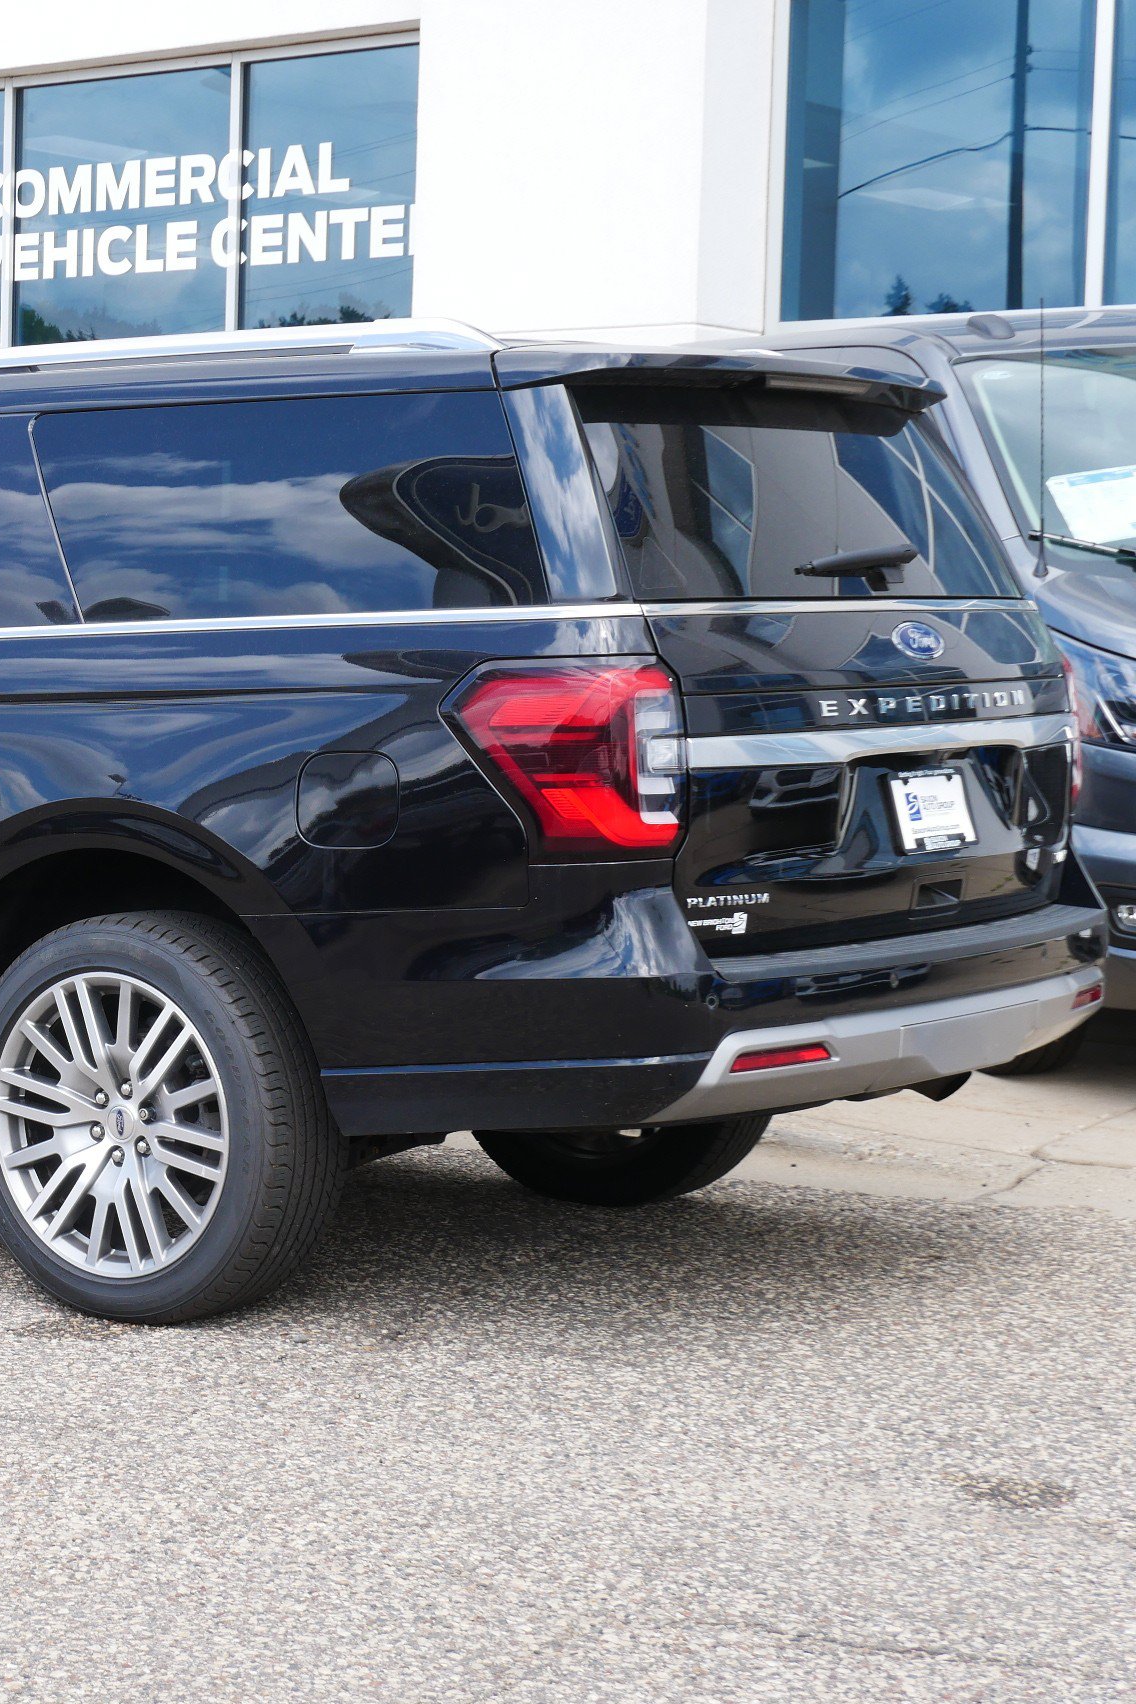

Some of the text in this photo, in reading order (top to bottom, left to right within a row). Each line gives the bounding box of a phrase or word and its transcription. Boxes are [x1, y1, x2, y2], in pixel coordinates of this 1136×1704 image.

[906, 627, 938, 650] Ford
[818, 689, 1025, 717] EXPEDITION
[686, 892, 770, 909] PLATINUM
[715, 923, 733, 931] FORD
